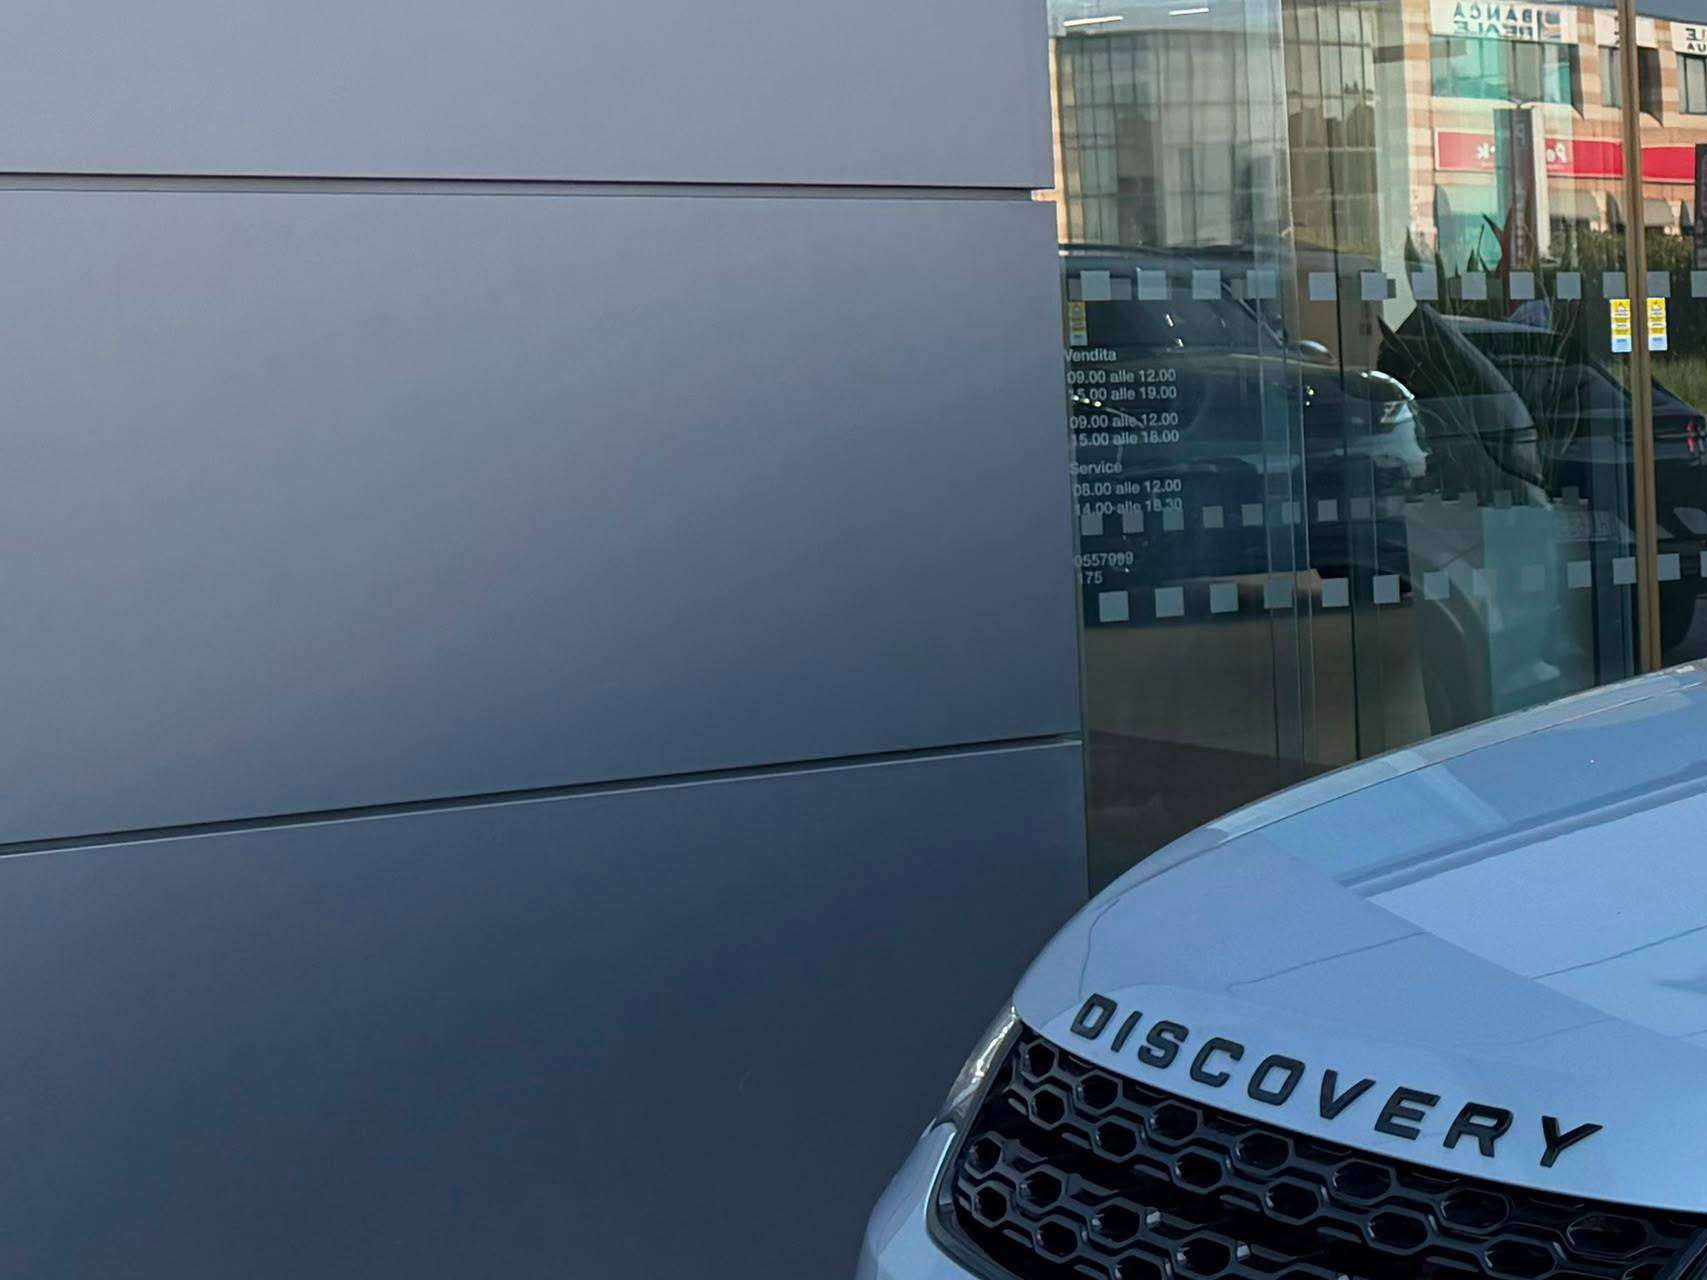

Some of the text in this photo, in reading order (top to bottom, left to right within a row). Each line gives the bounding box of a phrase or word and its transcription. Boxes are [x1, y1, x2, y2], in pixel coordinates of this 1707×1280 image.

[1065, 348, 1117, 362] Vendita
[1067, 368, 1177, 384] 09.00 alle 12.00
[1111, 387, 1136, 400] alle
[1140, 386, 1177, 400] 19.00
[1070, 415, 1108, 429] 09.00
[1141, 412, 1179, 426] 12.00
[1072, 429, 1180, 446] 15.00 alle 18.00
[1070, 460, 1123, 475] Service
[1073, 479, 1182, 497] 08.00 alle 12.00
[1069, 992, 1603, 1168] DISCOVERY
